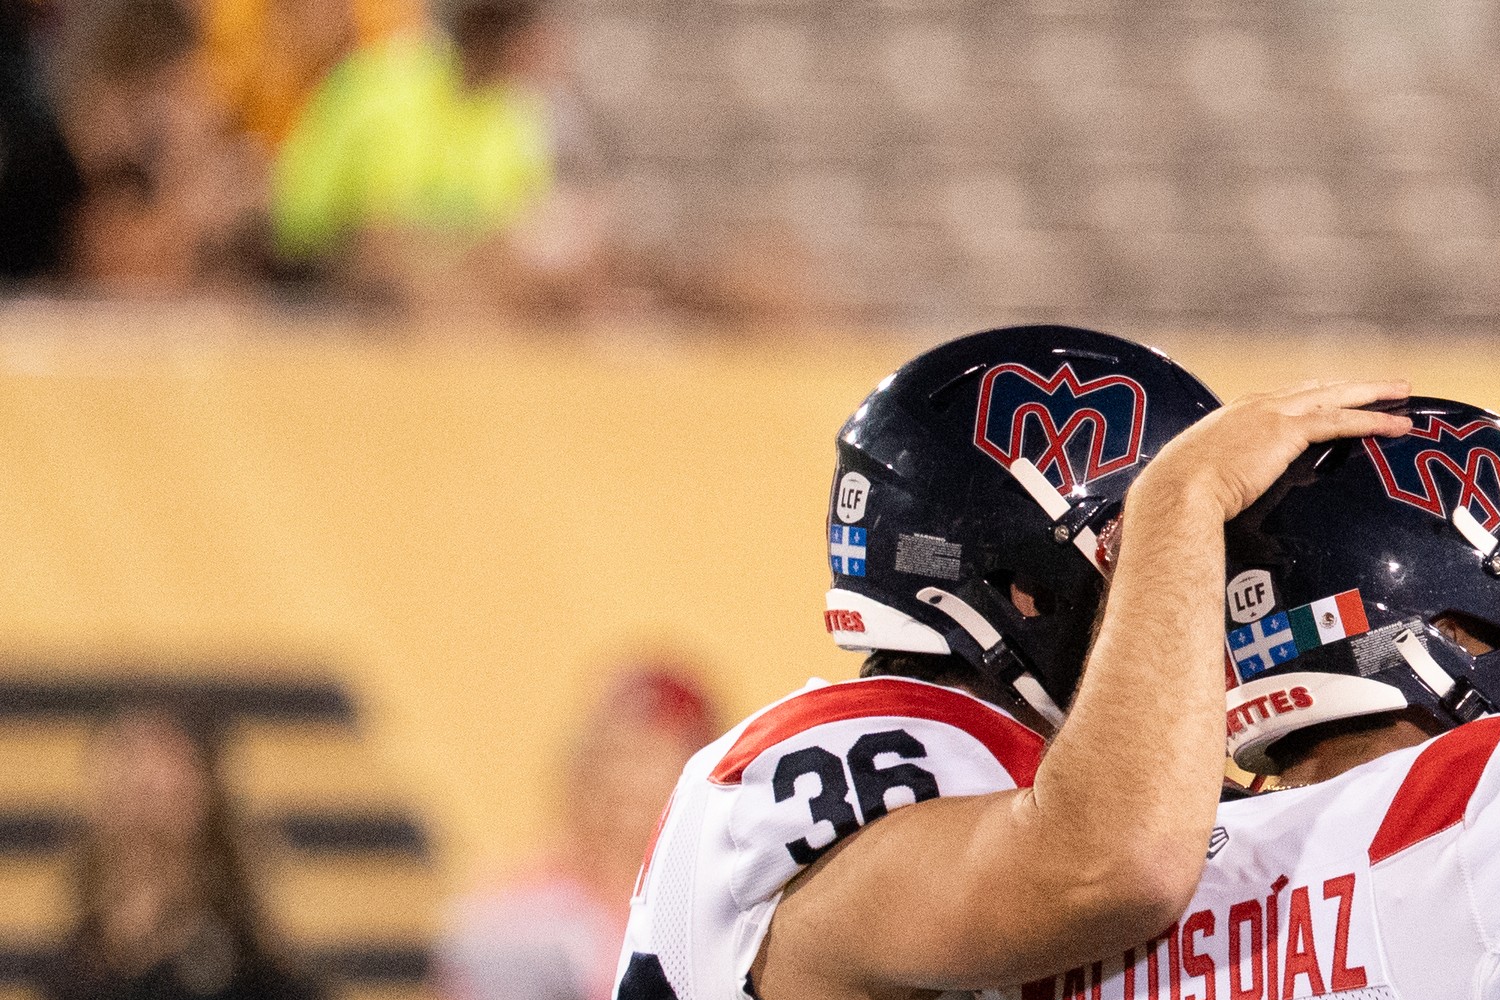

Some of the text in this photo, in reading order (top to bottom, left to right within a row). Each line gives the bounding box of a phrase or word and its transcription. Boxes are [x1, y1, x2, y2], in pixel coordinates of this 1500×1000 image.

[840, 487, 863, 510] LCF
[1233, 582, 1266, 612] LCF
[1366, 621, 1403, 636] WARNING
[1226, 686, 1314, 737] ETTES
[772, 728, 941, 865] 36
